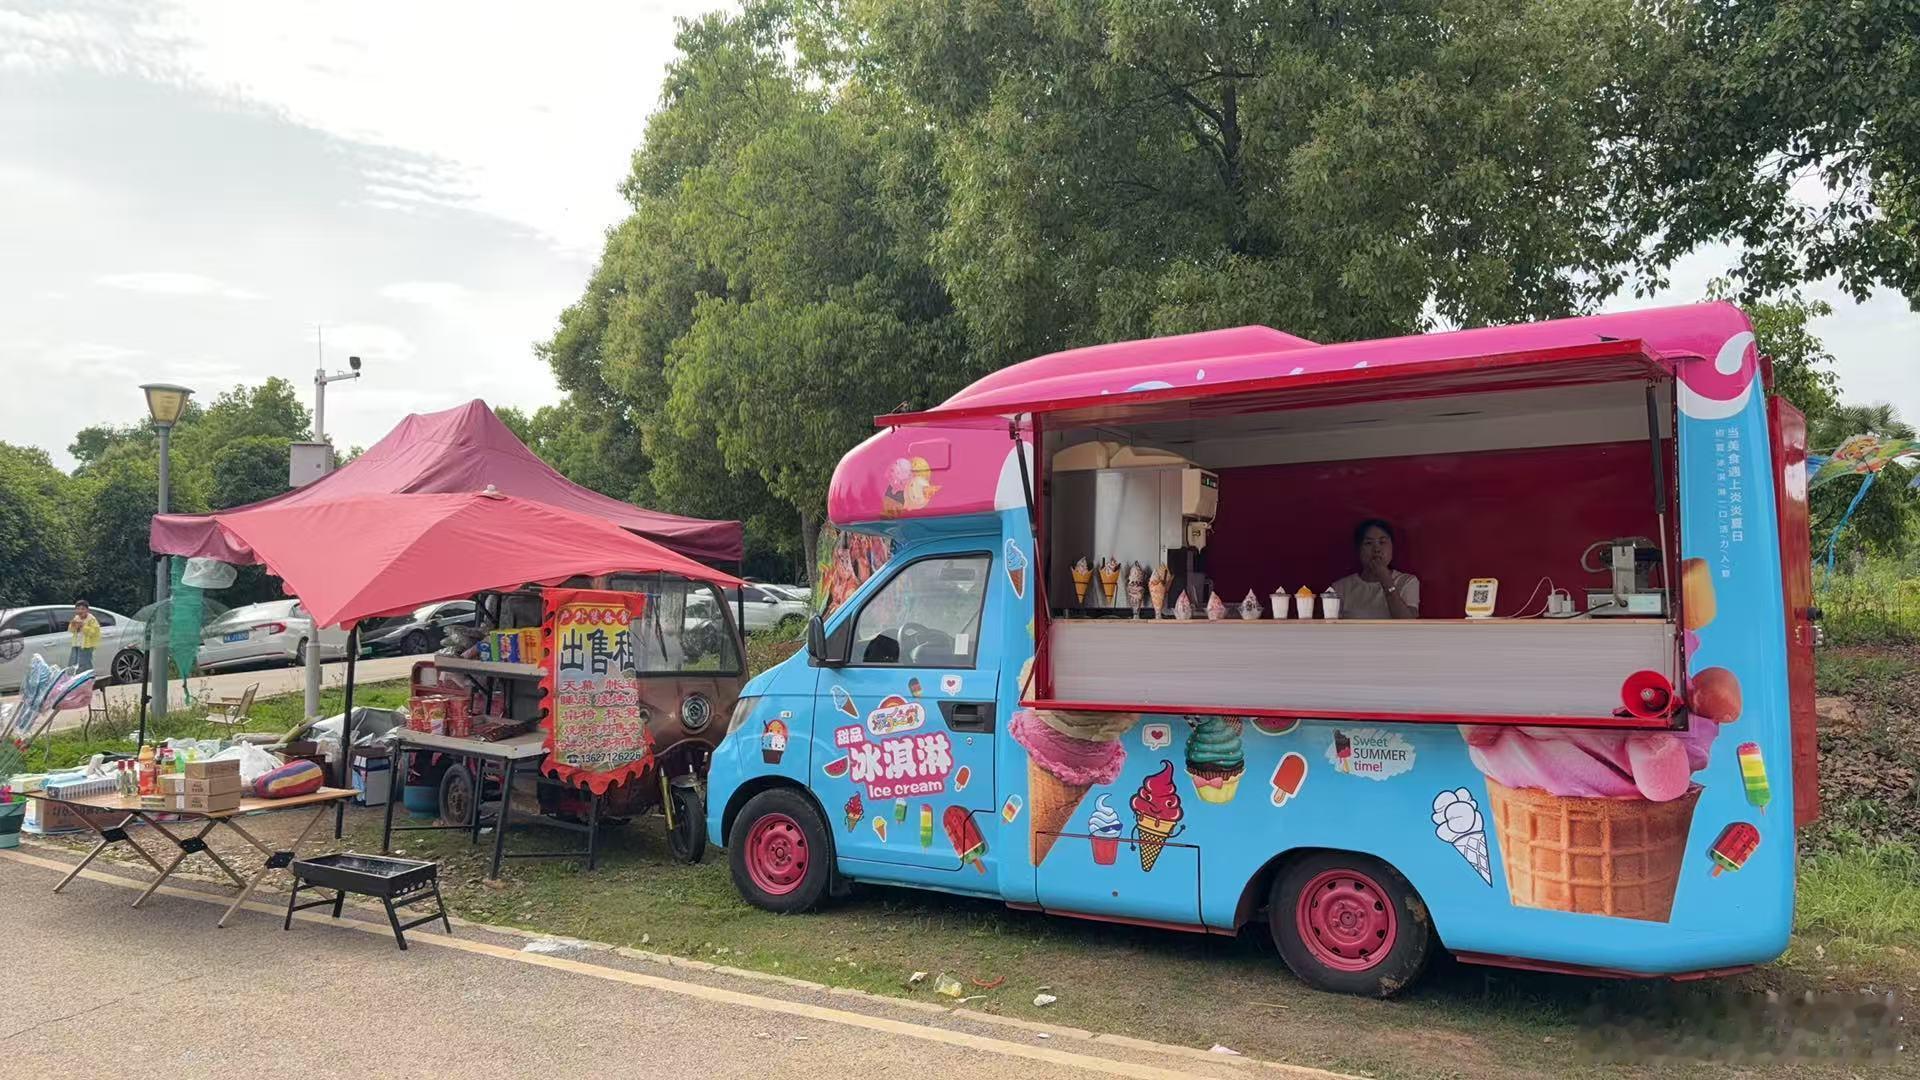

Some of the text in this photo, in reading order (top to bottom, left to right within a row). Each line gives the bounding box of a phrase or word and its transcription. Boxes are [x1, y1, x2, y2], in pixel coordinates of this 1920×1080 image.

[1727, 427, 1743, 541] 当美食遇上炎炎夏日
[559, 628, 635, 675] 出售租
[560, 680, 595, 692] 天幕
[837, 727, 863, 746] 甜品
[1353, 735, 1388, 747] Sweet
[581, 751, 641, 763] 13627126226
[851, 735, 952, 781] 冰淇淋
[1353, 748, 1407, 761] SUMMER
[1354, 760, 1383, 772] time!
[868, 781, 943, 799] Ice cream
